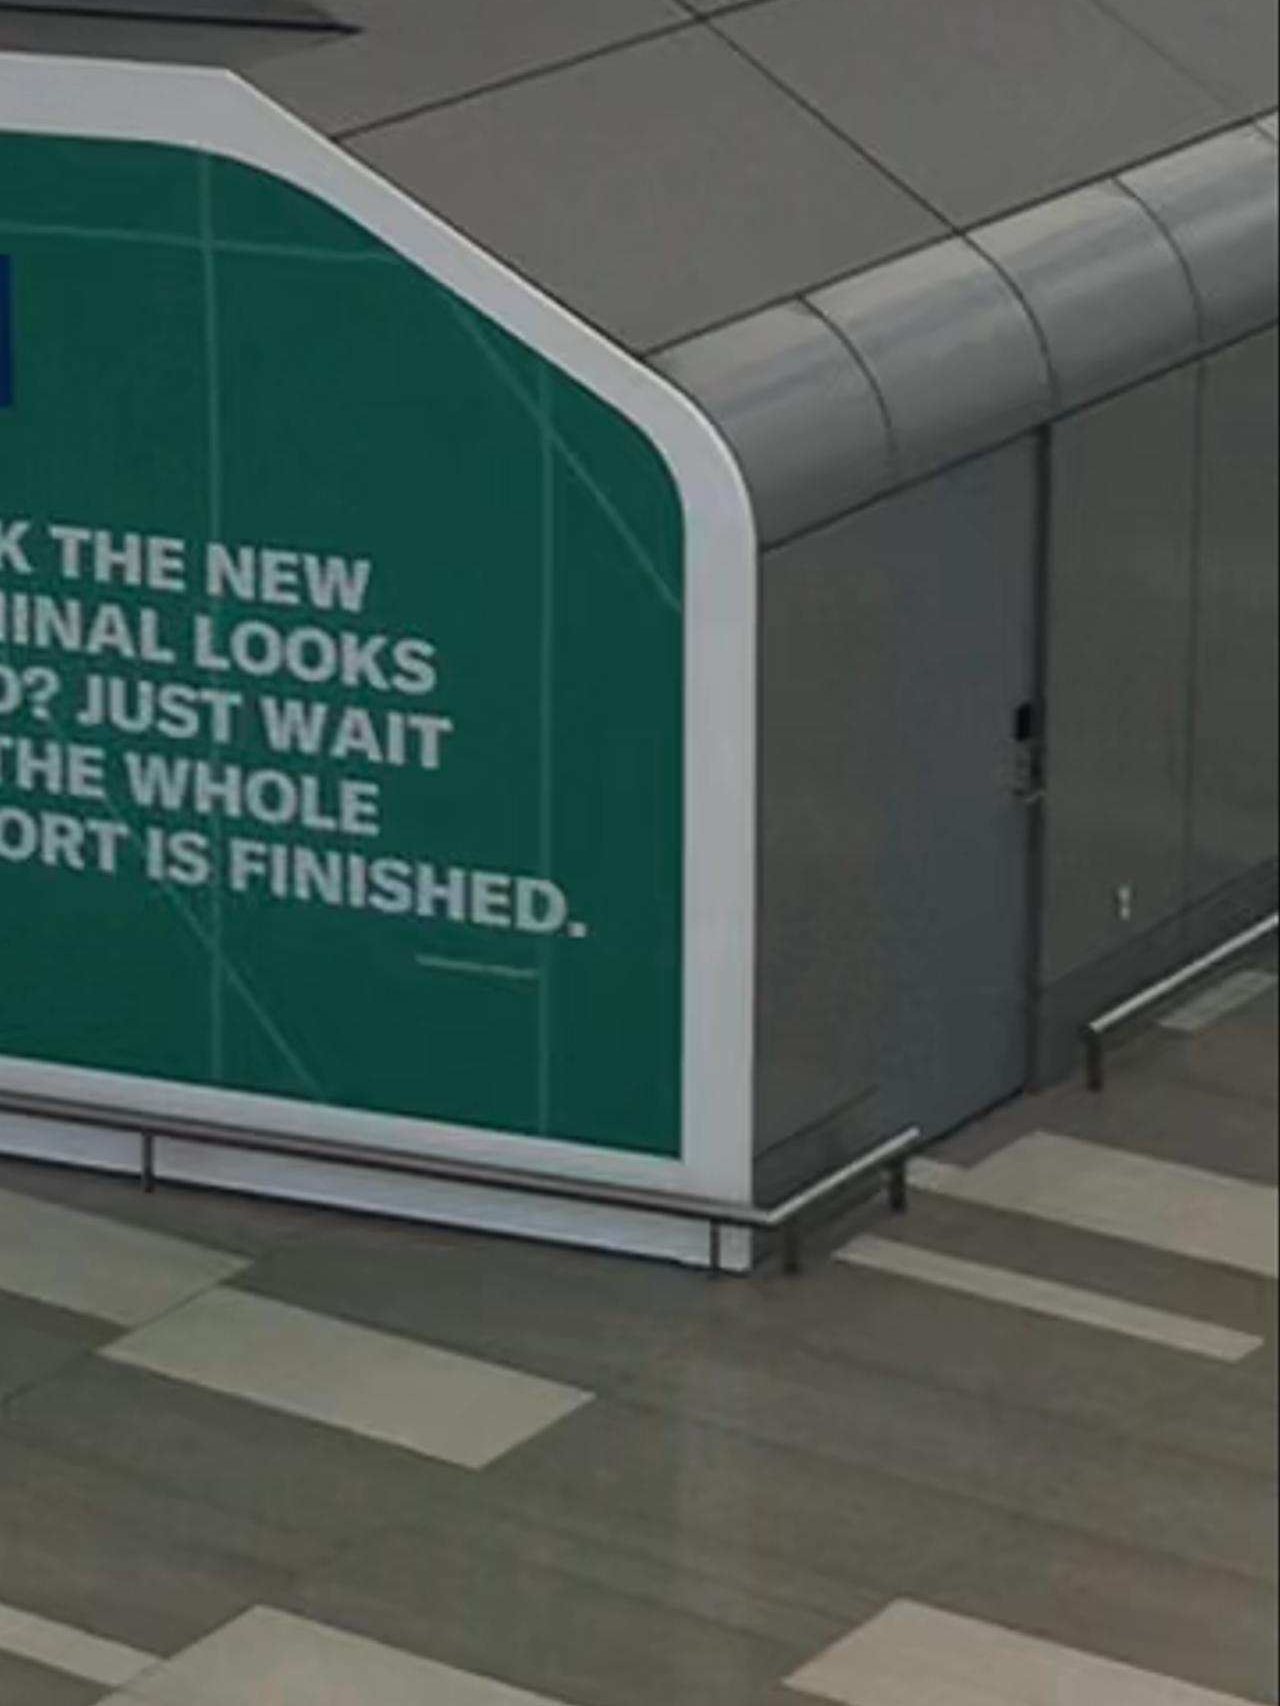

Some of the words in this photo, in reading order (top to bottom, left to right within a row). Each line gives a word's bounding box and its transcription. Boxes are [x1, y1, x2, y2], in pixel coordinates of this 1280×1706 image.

[49, 524, 186, 592] THE
[206, 542, 371, 613] NEW
[193, 614, 438, 695] LOOKS
[76, 672, 244, 744] JUST
[258, 694, 455, 770] WAIT
[122, 750, 380, 837] WHOLE
[146, 825, 210, 886] IS
[229, 838, 588, 938] FINISHED.
